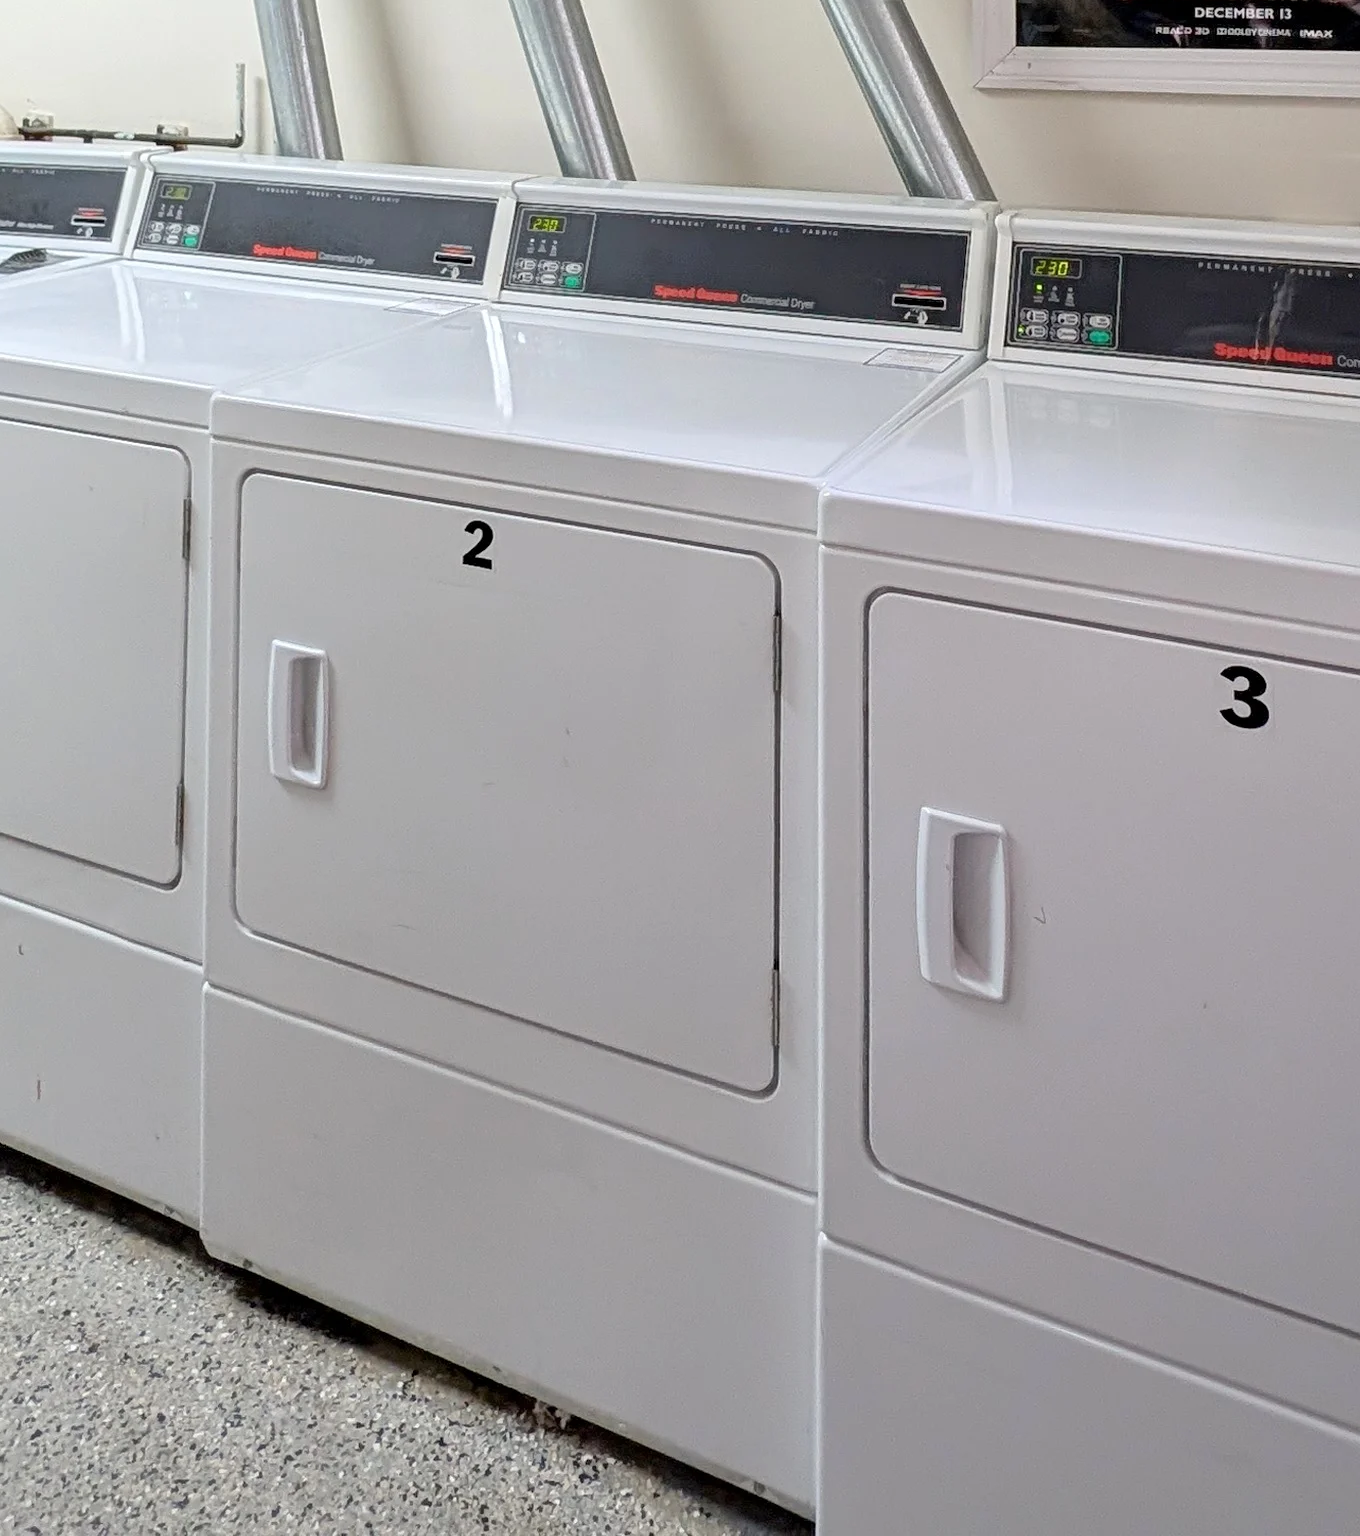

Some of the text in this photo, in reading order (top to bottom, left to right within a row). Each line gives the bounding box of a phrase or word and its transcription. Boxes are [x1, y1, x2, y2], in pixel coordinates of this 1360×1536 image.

[1194, 7, 1293, 20] DECEMBER 13
[1194, 27, 1210, 36] 3D
[1299, 29, 1334, 39] IMAX
[357, 253, 376, 266] Dryer
[1035, 260, 1069, 276] 230
[1198, 261, 1274, 274] PERMANENT
[1290, 268, 1332, 278] PRESS
[653, 284, 695, 301] Speed
[740, 293, 790, 308] Commercial
[790, 295, 816, 311] Dryer
[1213, 341, 1272, 361] Speed
[1272, 347, 1335, 366] Queen
[462, 520, 495, 570] 2
[1219, 665, 1270, 729] 3
